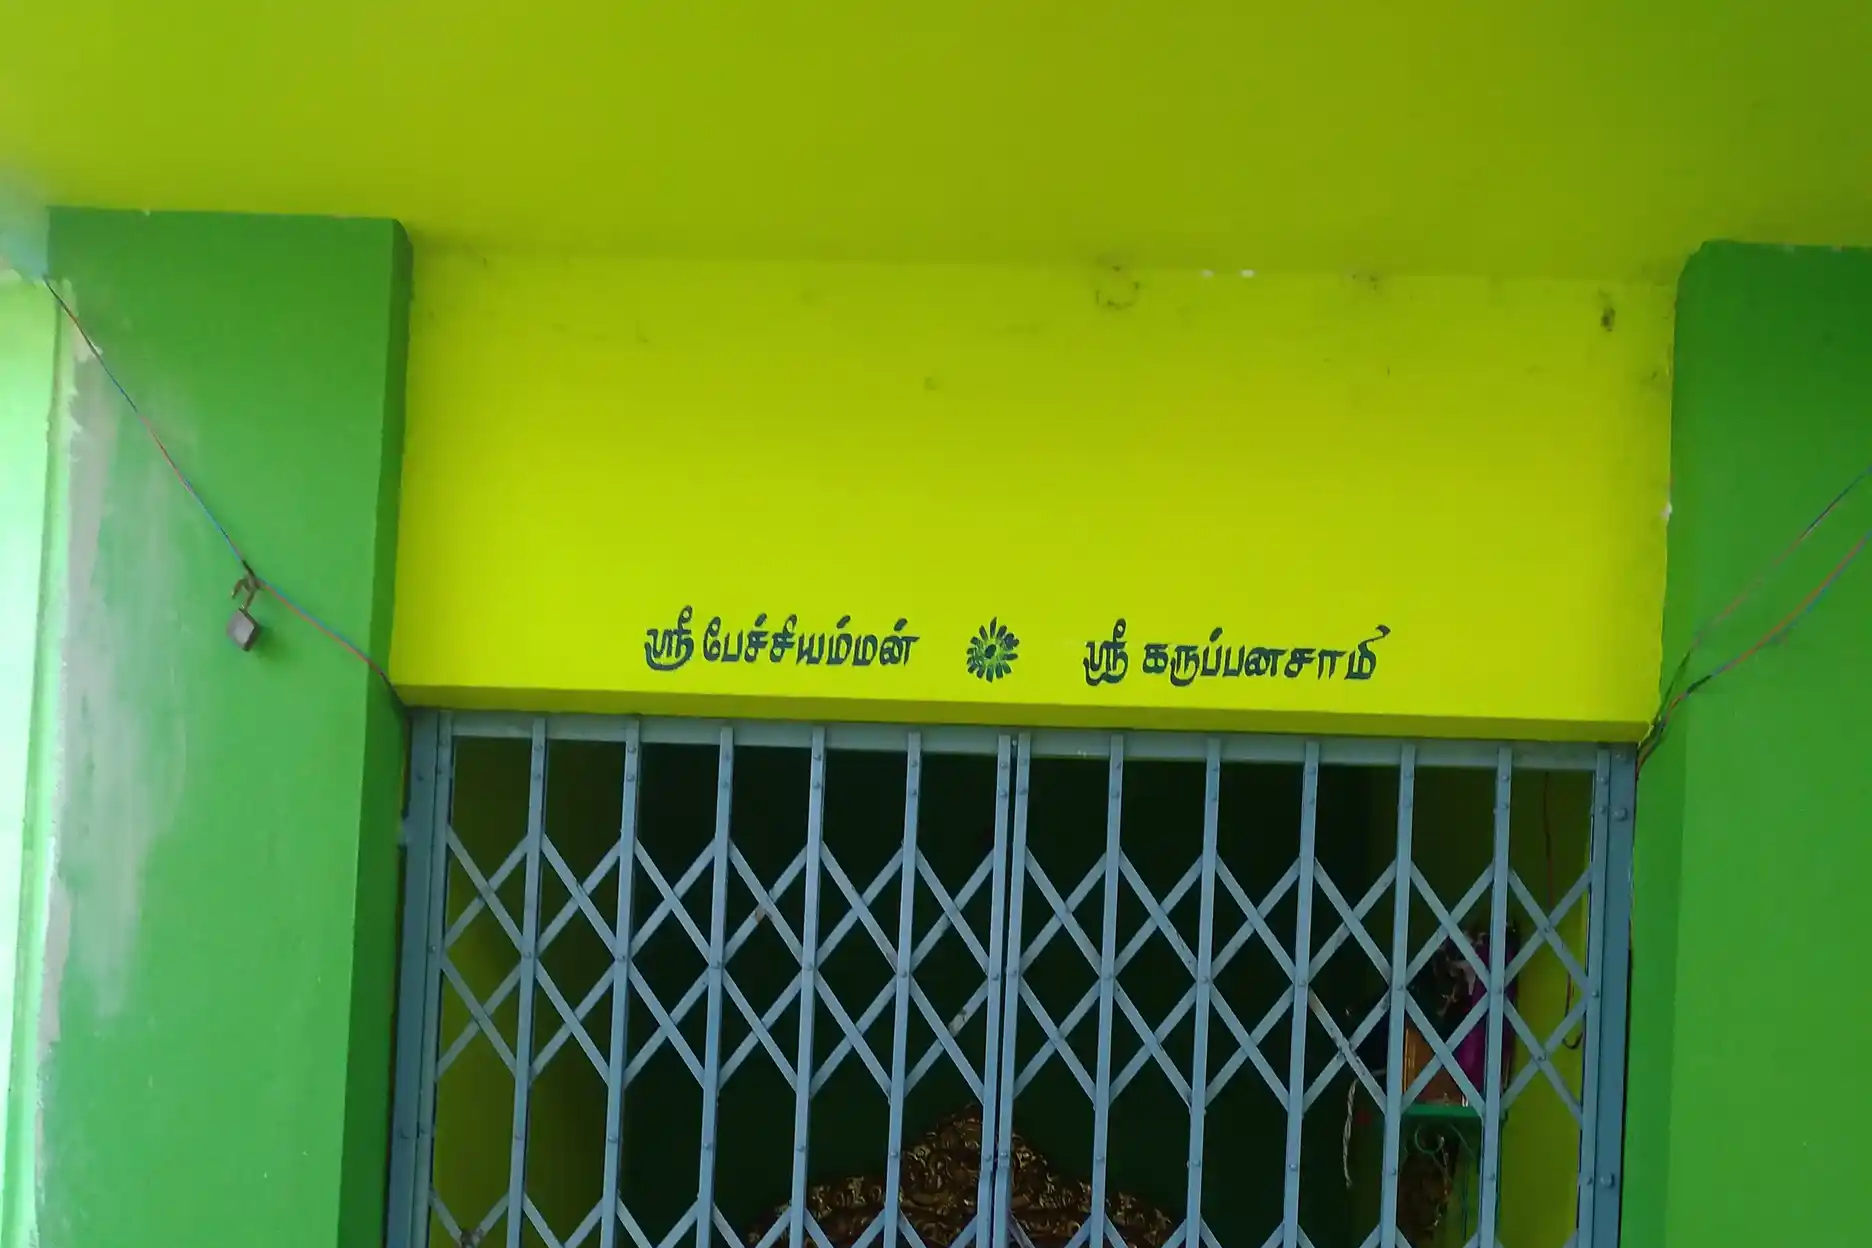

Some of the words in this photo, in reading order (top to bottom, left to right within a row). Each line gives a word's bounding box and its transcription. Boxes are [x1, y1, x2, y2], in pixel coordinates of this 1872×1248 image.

[643, 604, 696, 672] ஸ்ரீ
[702, 613, 921, 667] பேச்சியம்மன்
[1082, 617, 1130, 687] ஸ்ரீ
[1142, 624, 1392, 687] கருப்பனசாமி
